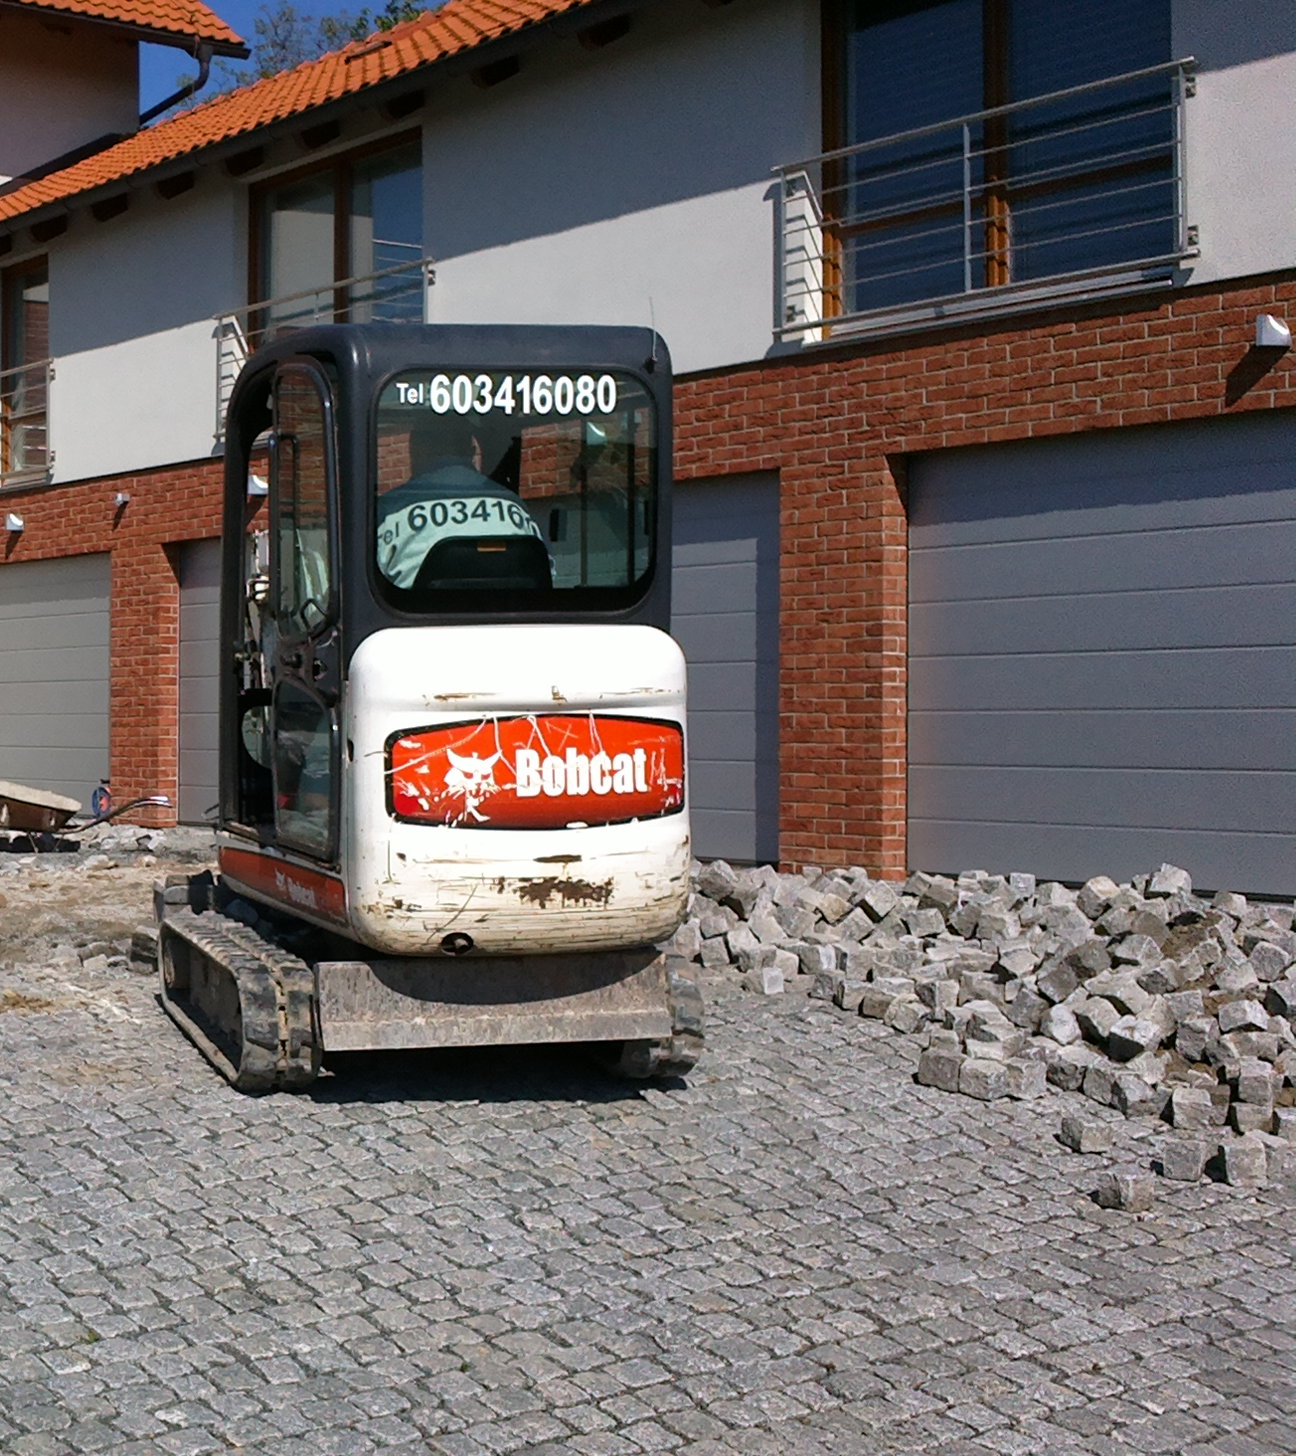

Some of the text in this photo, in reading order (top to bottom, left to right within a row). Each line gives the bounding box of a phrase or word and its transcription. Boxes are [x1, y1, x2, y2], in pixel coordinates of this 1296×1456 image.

[396, 374, 617, 415] Tel 603416080
[515, 747, 649, 796] Bobcat
